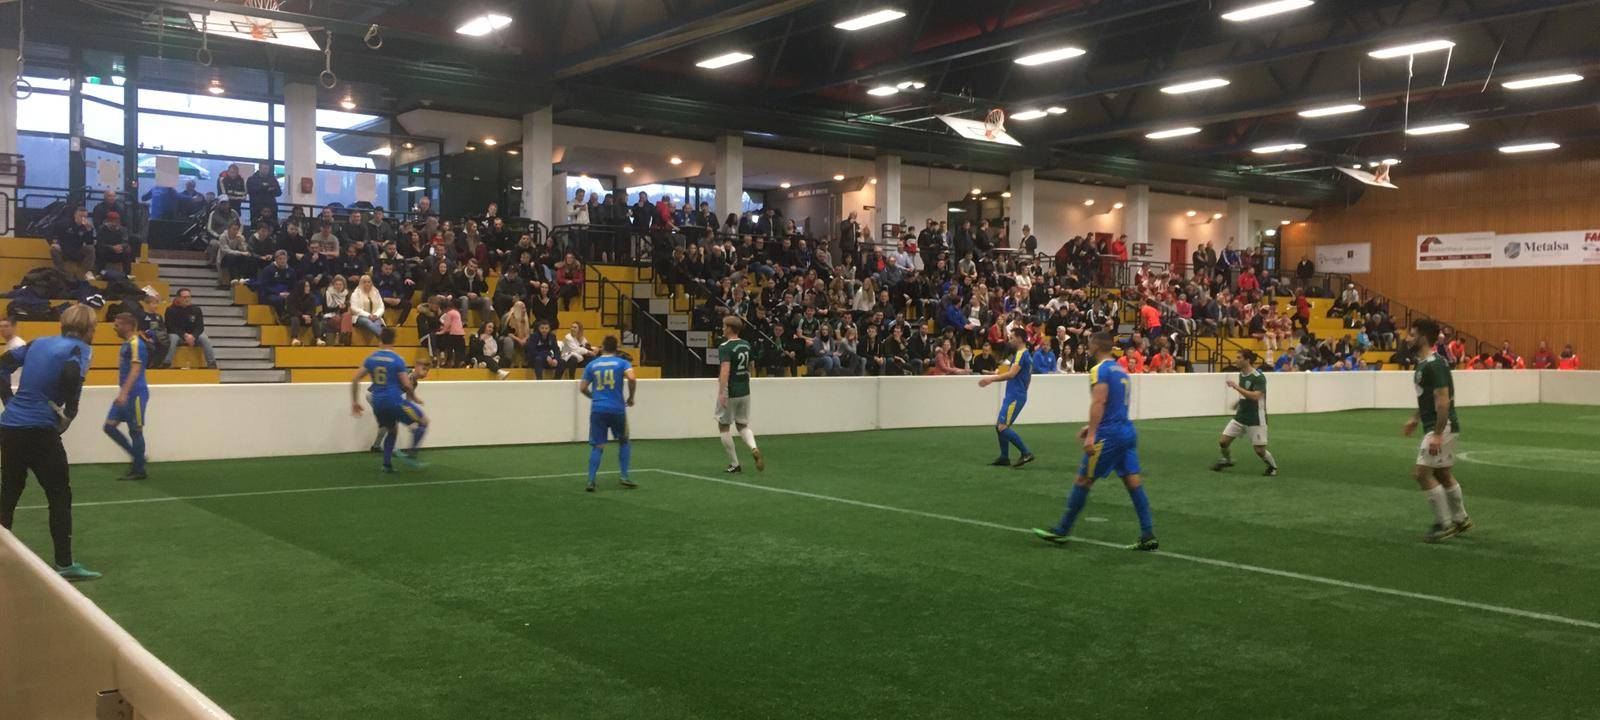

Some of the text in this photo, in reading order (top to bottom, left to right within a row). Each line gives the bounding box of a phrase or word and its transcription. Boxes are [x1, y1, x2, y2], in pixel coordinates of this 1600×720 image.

[1524, 241, 1569, 252] Metalsa
[737, 351, 749, 370] 21
[374, 366, 386, 384] 6
[594, 369, 615, 391] 14
